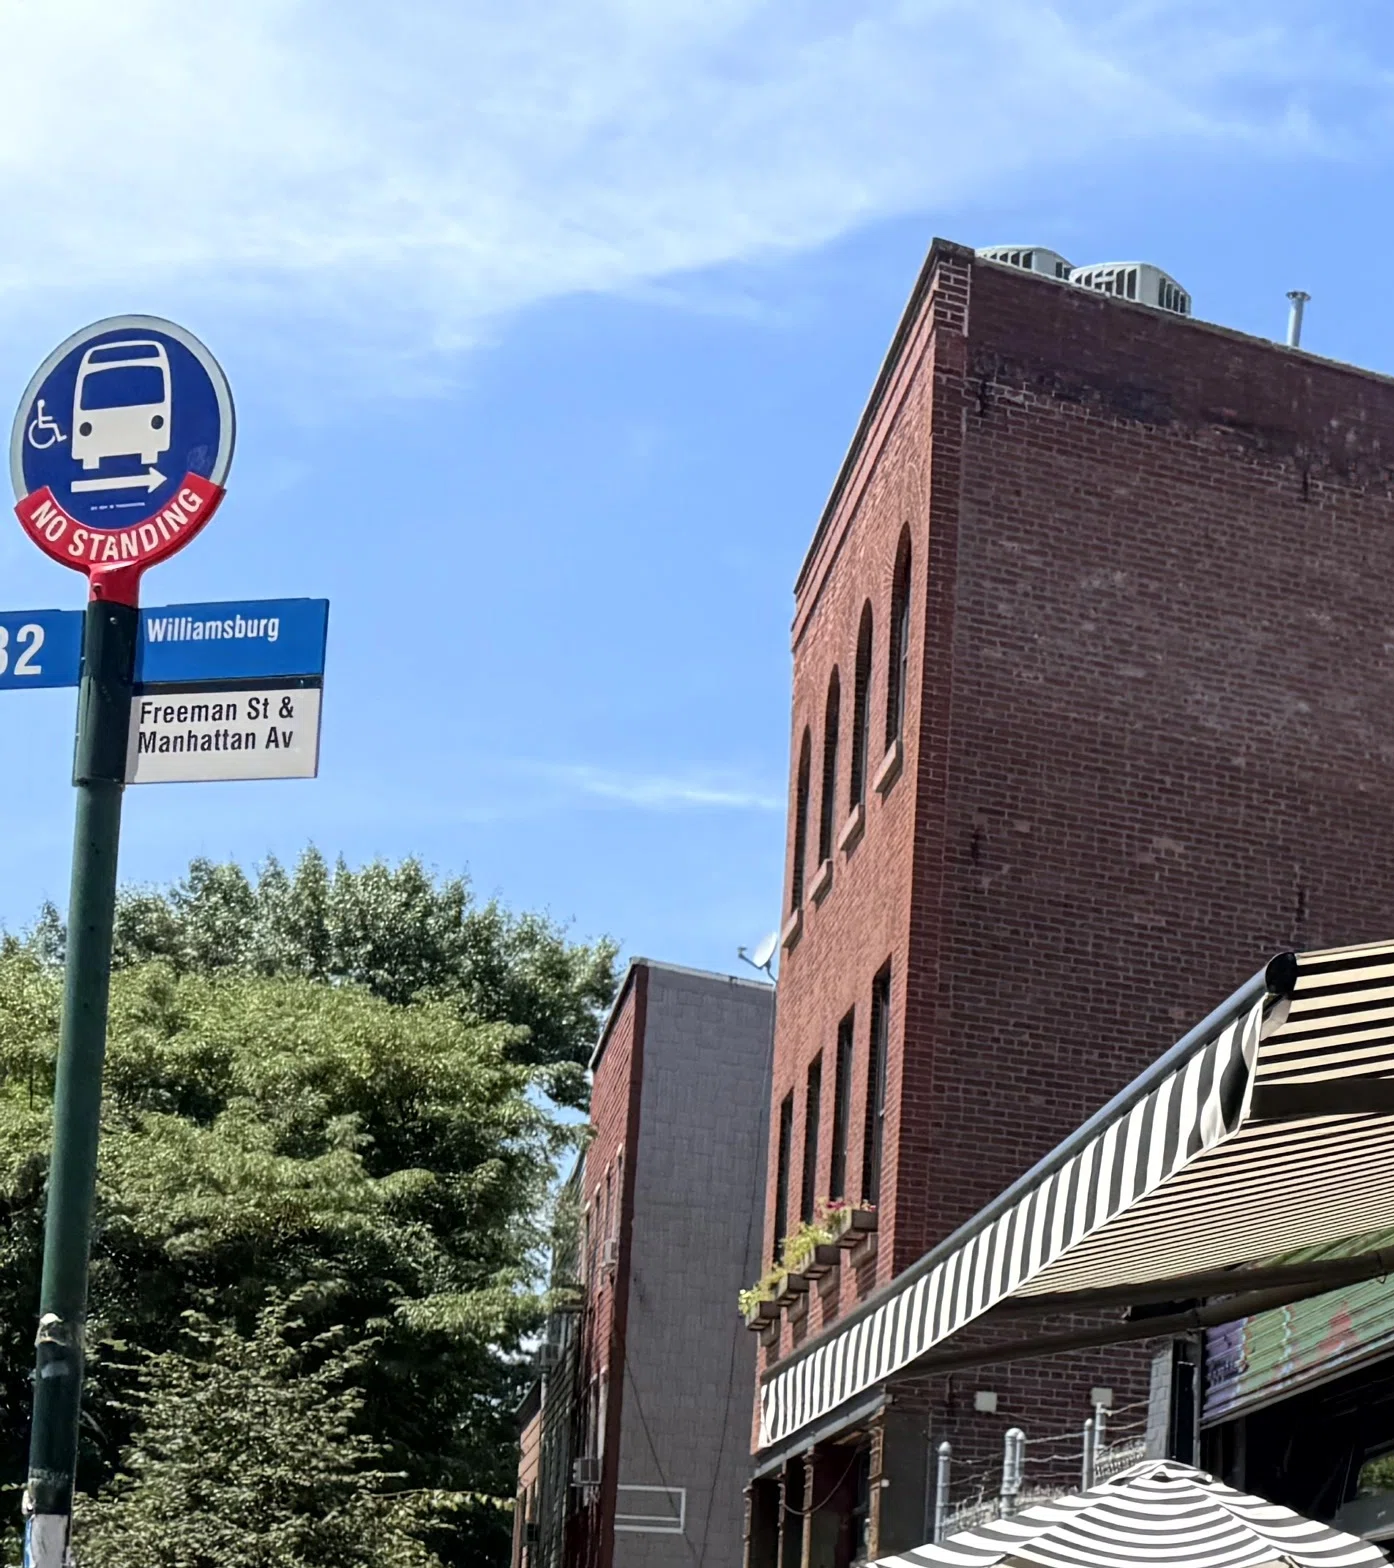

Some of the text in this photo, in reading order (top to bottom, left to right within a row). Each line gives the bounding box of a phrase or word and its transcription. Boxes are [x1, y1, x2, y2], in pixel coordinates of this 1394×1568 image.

[30, 488, 204, 561] NO STANDING
[147, 615, 280, 642] Williamsburg
[0, 624, 46, 675] 2
[140, 696, 294, 724] Freeman St &
[138, 727, 294, 754] Manhattan Av
